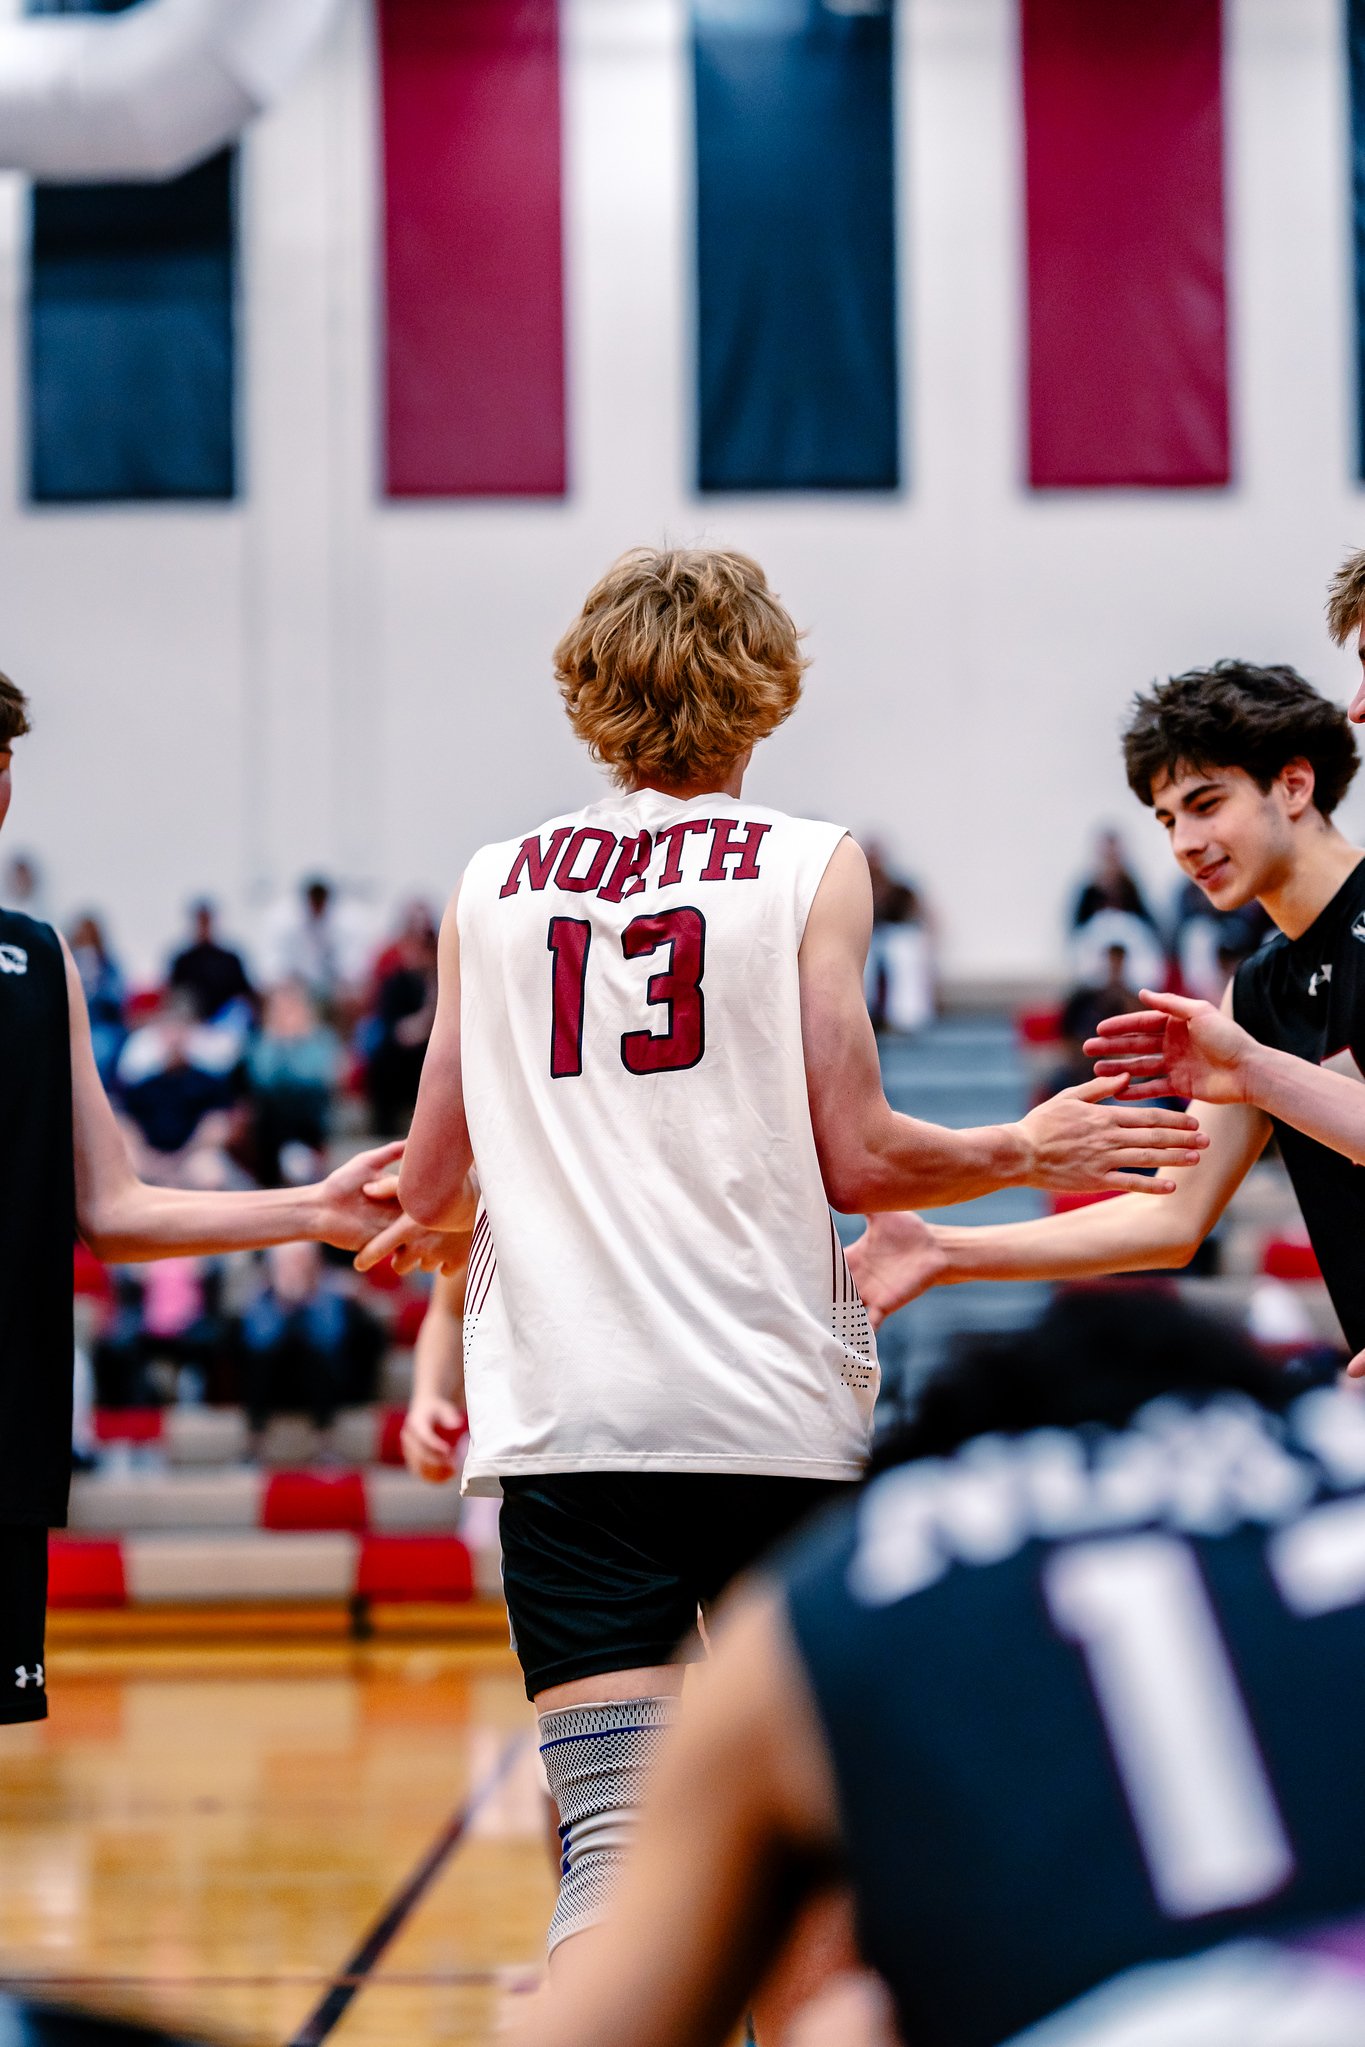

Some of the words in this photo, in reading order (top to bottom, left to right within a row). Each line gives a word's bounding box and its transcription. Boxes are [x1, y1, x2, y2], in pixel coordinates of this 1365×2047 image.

[499, 818, 772, 903] NORTH
[548, 906, 706, 1078] 13
[1043, 1499, 1365, 1920] 1
